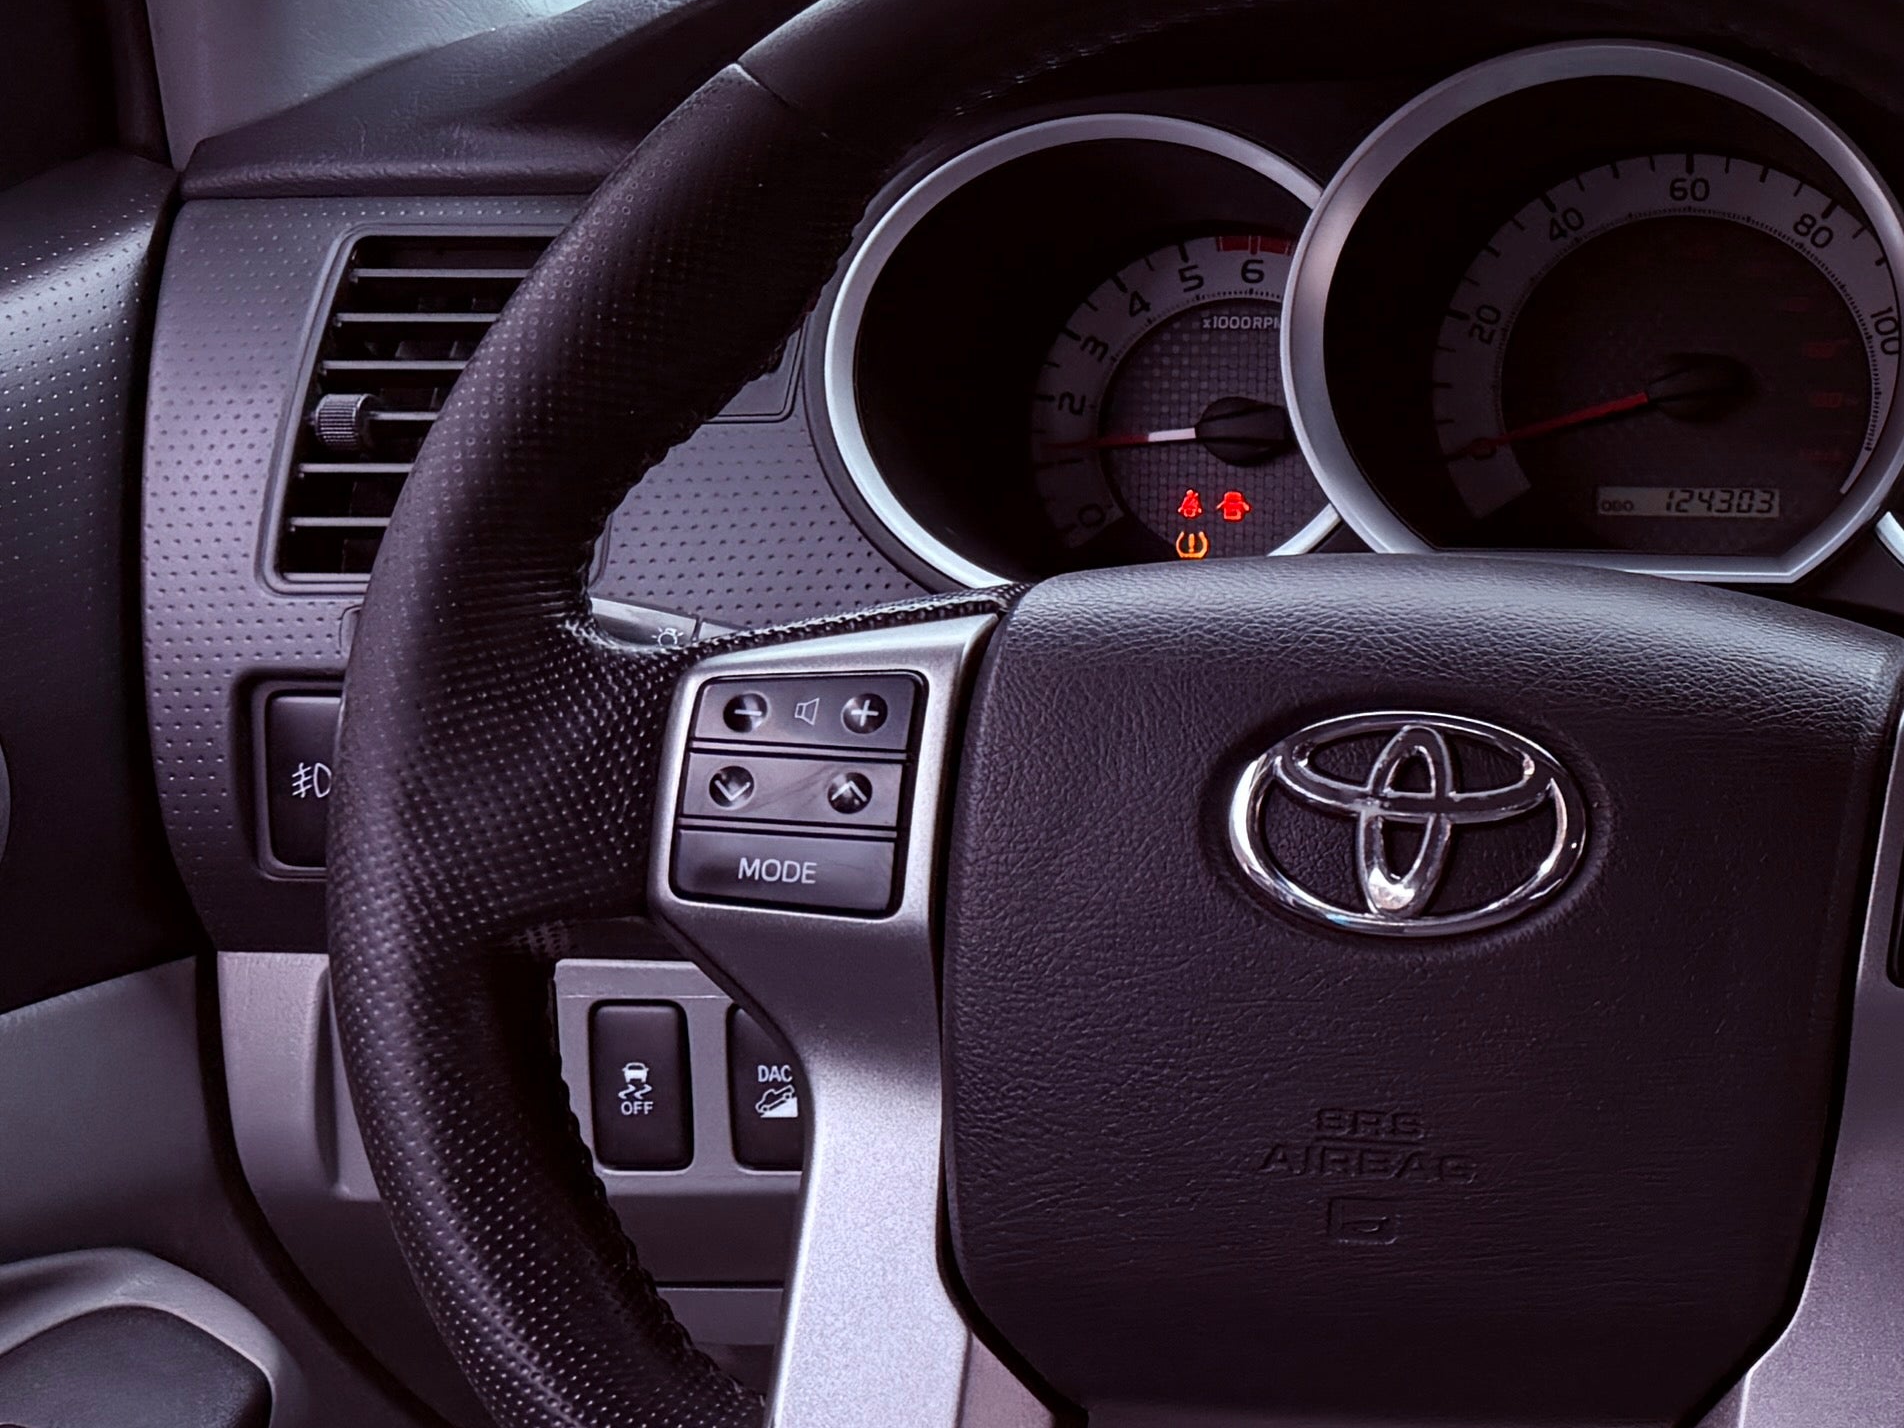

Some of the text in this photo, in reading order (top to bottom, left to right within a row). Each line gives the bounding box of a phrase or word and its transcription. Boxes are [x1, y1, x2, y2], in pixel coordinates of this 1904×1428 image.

[1669, 177, 1711, 202] 60
[1546, 206, 1585, 244] 40
[1792, 212, 1835, 250] 80
[1179, 266, 1205, 293] 5
[1242, 259, 1265, 283] 6
[1128, 293, 1151, 318] 4
[1467, 304, 1502, 345] 20
[1869, 307, 1901, 357] 100
[1082, 334, 1110, 365] 3
[1059, 391, 1086, 415] 2
[1666, 489, 1775, 514] 124303
[737, 857, 818, 885] MODE
[757, 1065, 793, 1084] DAC
[620, 1100, 654, 1116] OFF
[1260, 1144, 1478, 1184] AIRBAG
